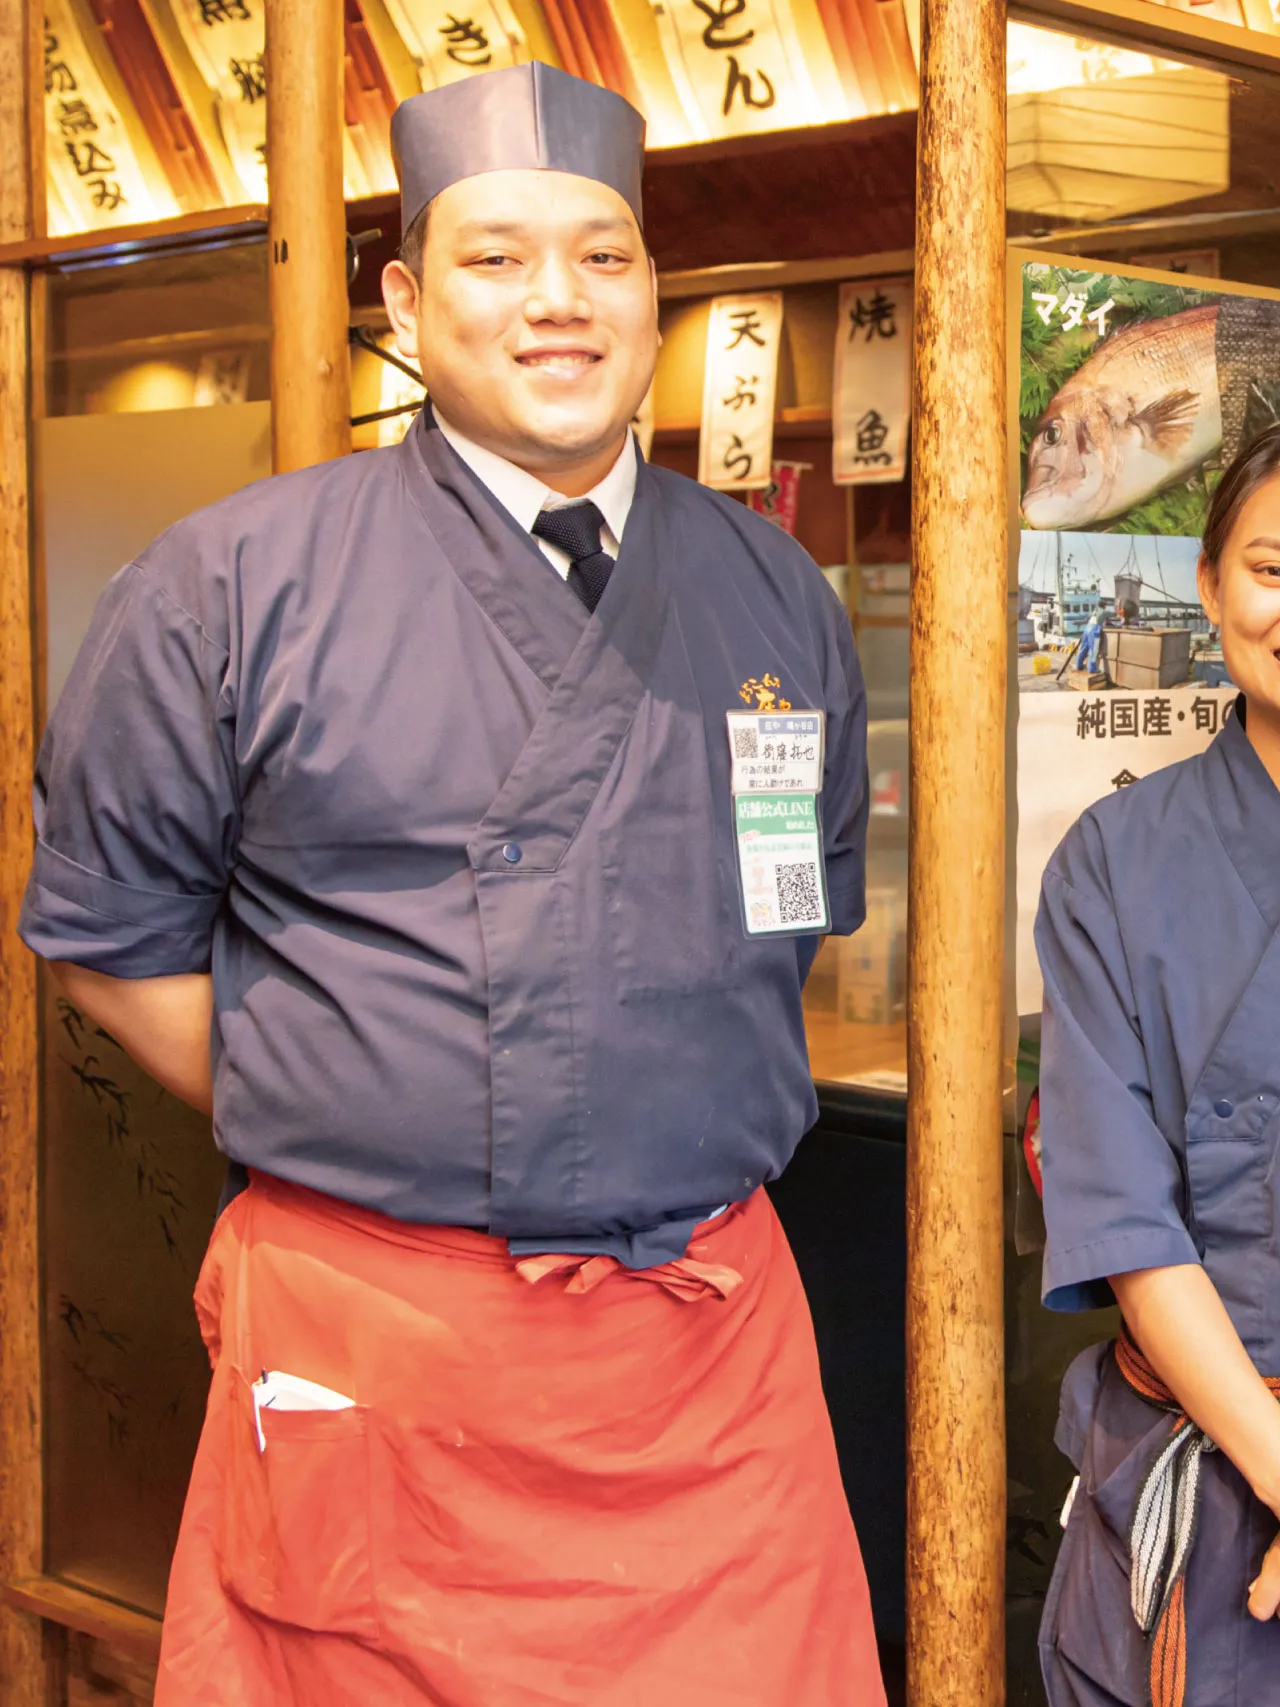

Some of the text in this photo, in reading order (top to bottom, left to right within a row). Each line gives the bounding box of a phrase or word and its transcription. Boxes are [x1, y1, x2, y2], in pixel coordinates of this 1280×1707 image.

[1030, 290, 1115, 335] マダイ
[848, 290, 896, 466] 焼魚
